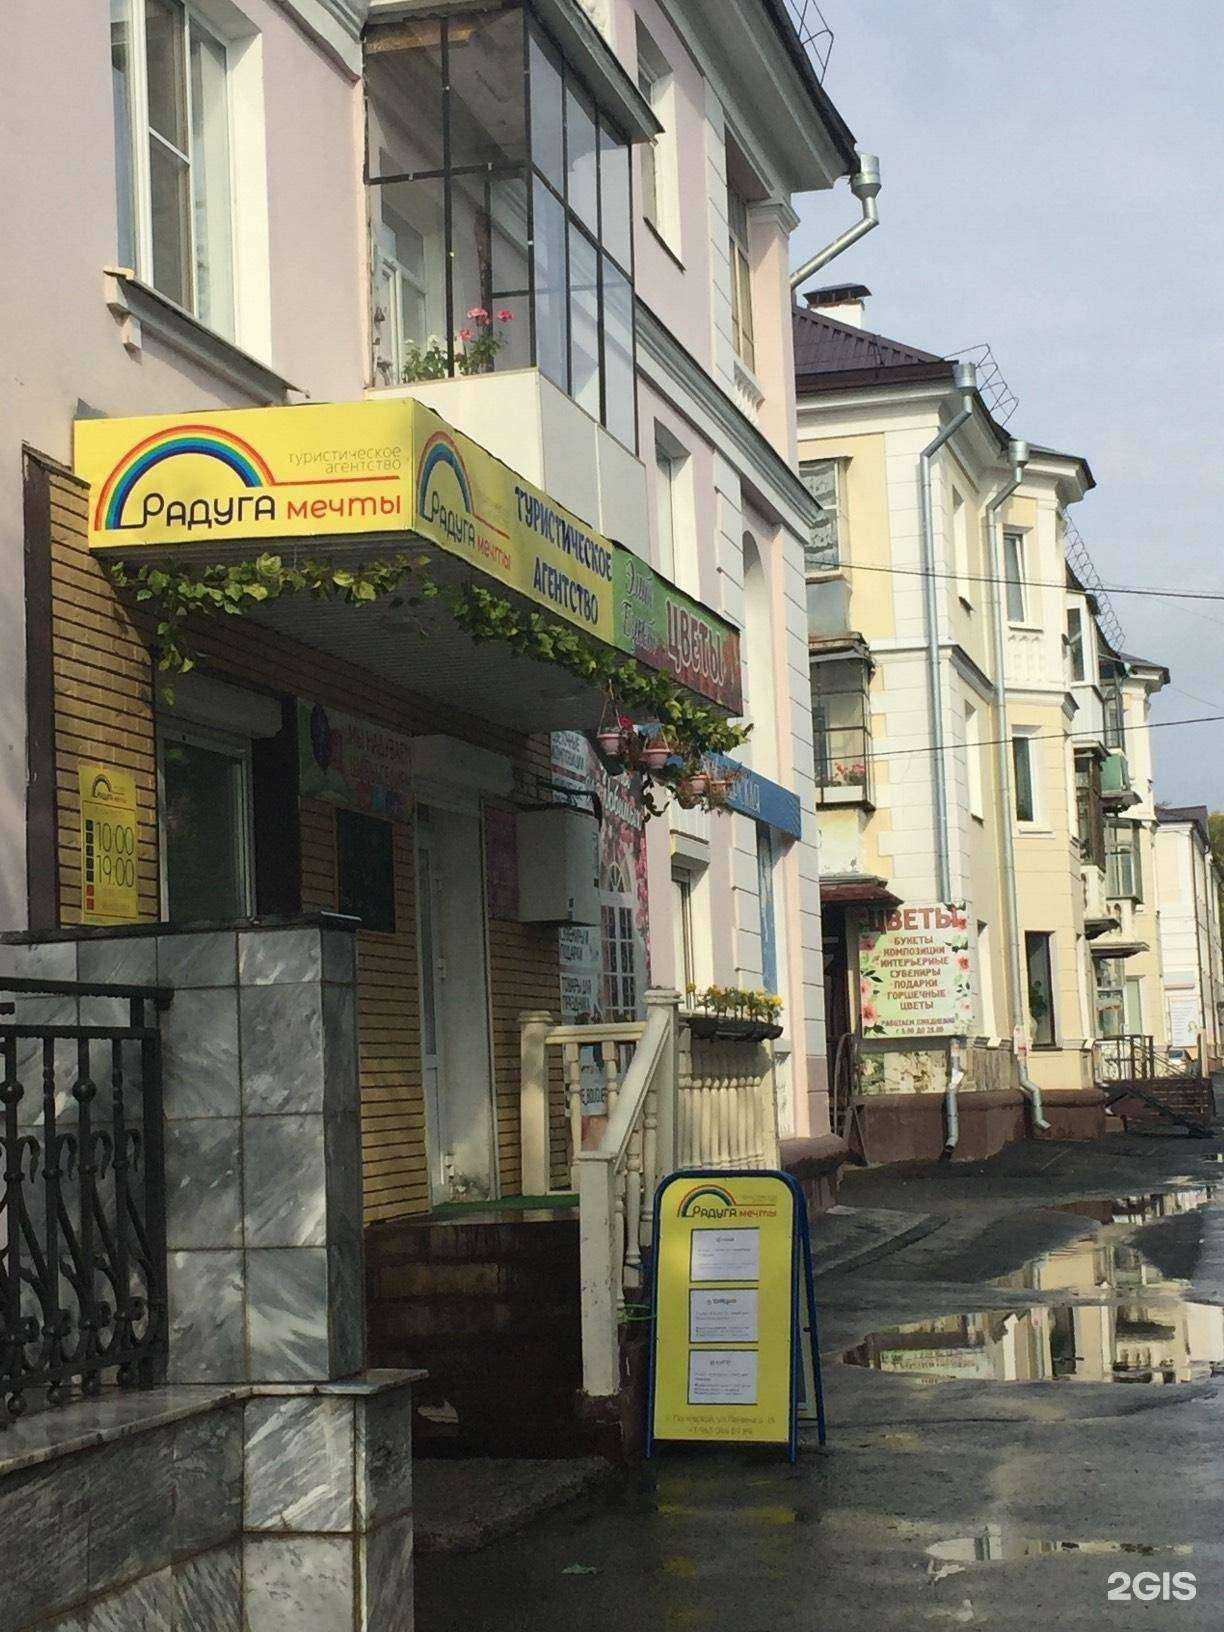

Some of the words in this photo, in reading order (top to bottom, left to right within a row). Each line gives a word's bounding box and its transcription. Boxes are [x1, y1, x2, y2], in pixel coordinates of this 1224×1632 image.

[288, 446, 401, 466] туристическое
[287, 495, 401, 520] мечты
[515, 486, 613, 582] ТУРИСТИЧЕСКОЕ
[533, 557, 599, 626] АГЕНТСТВО
[894, 936, 933, 945] БУКЕТЫ
[883, 946, 945, 957] КОМПОЗИЦИИ
[880, 957, 949, 968] ИНТЕРЬЕРНЫЕ
[890, 969, 941, 979] СУВЕНИРЫ
[894, 979, 938, 989] ПОДАРКИ
[887, 989, 946, 1000] ГОРШЕЧНЫЕ
[900, 1001, 934, 1011] ЦВЕТЫ
